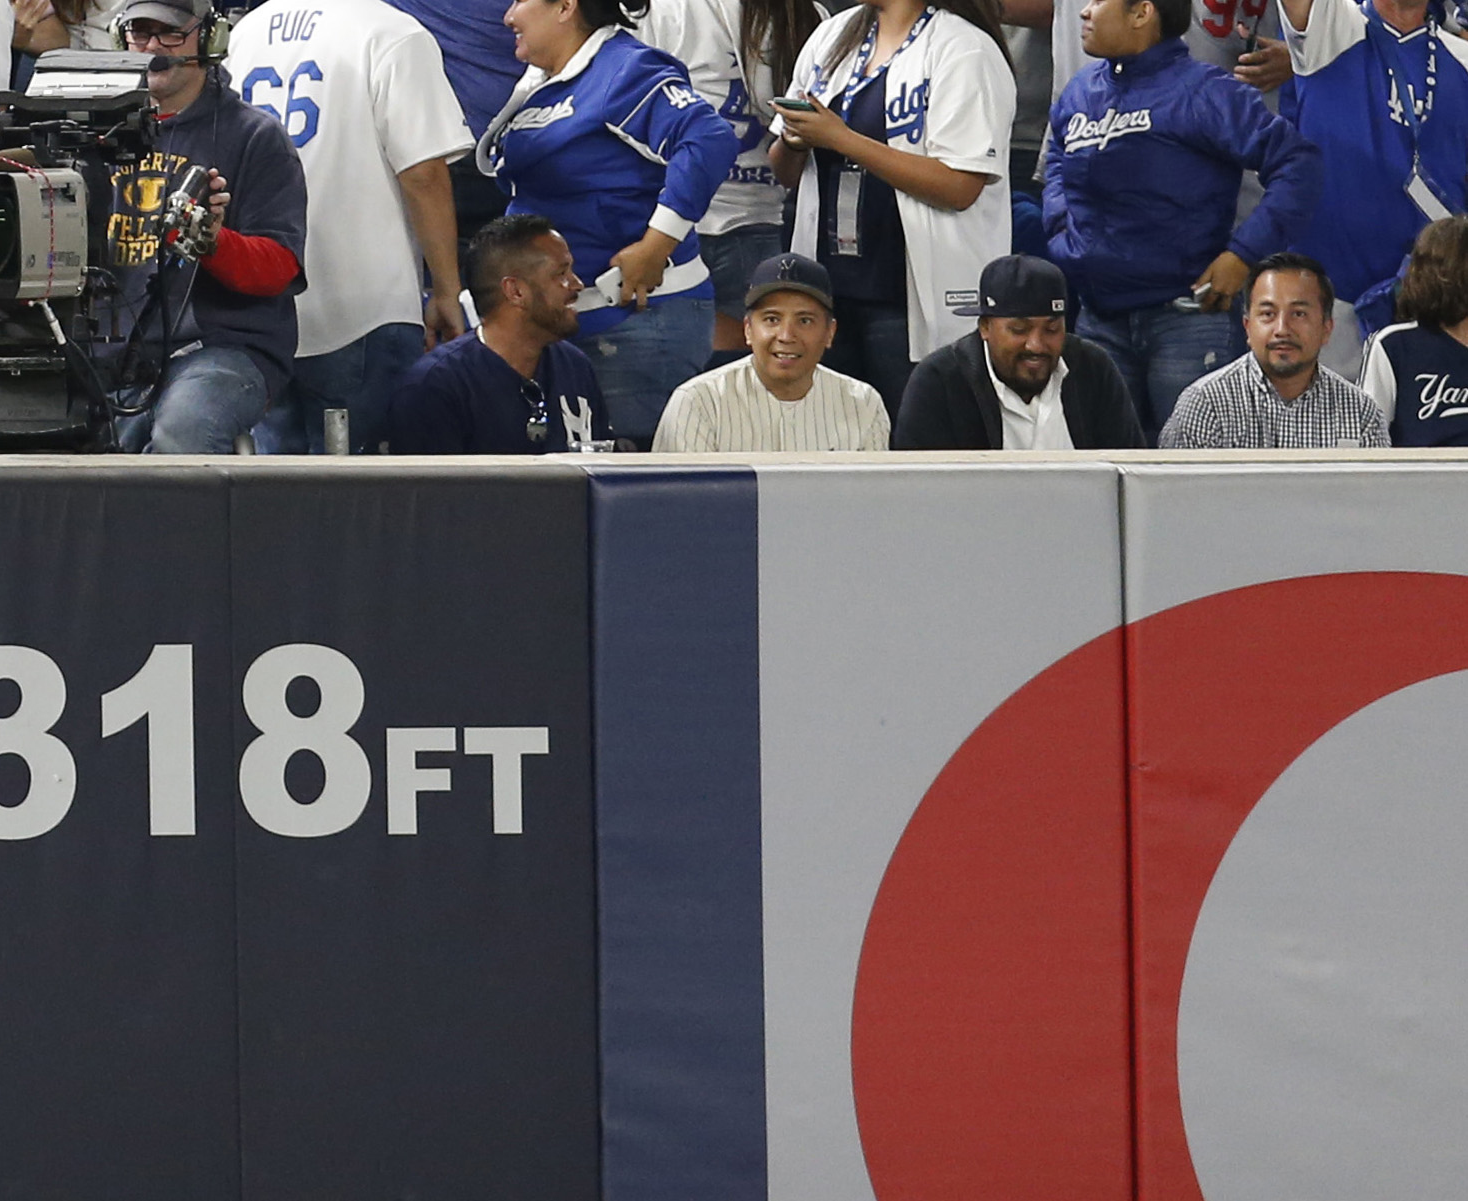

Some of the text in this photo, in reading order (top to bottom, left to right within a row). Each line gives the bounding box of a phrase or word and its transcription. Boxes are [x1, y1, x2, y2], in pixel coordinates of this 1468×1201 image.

[268, 10, 323, 45] PUIG
[241, 60, 323, 149] 66
[662, 84, 698, 109] LA
[1064, 108, 1151, 154] Dodgers
